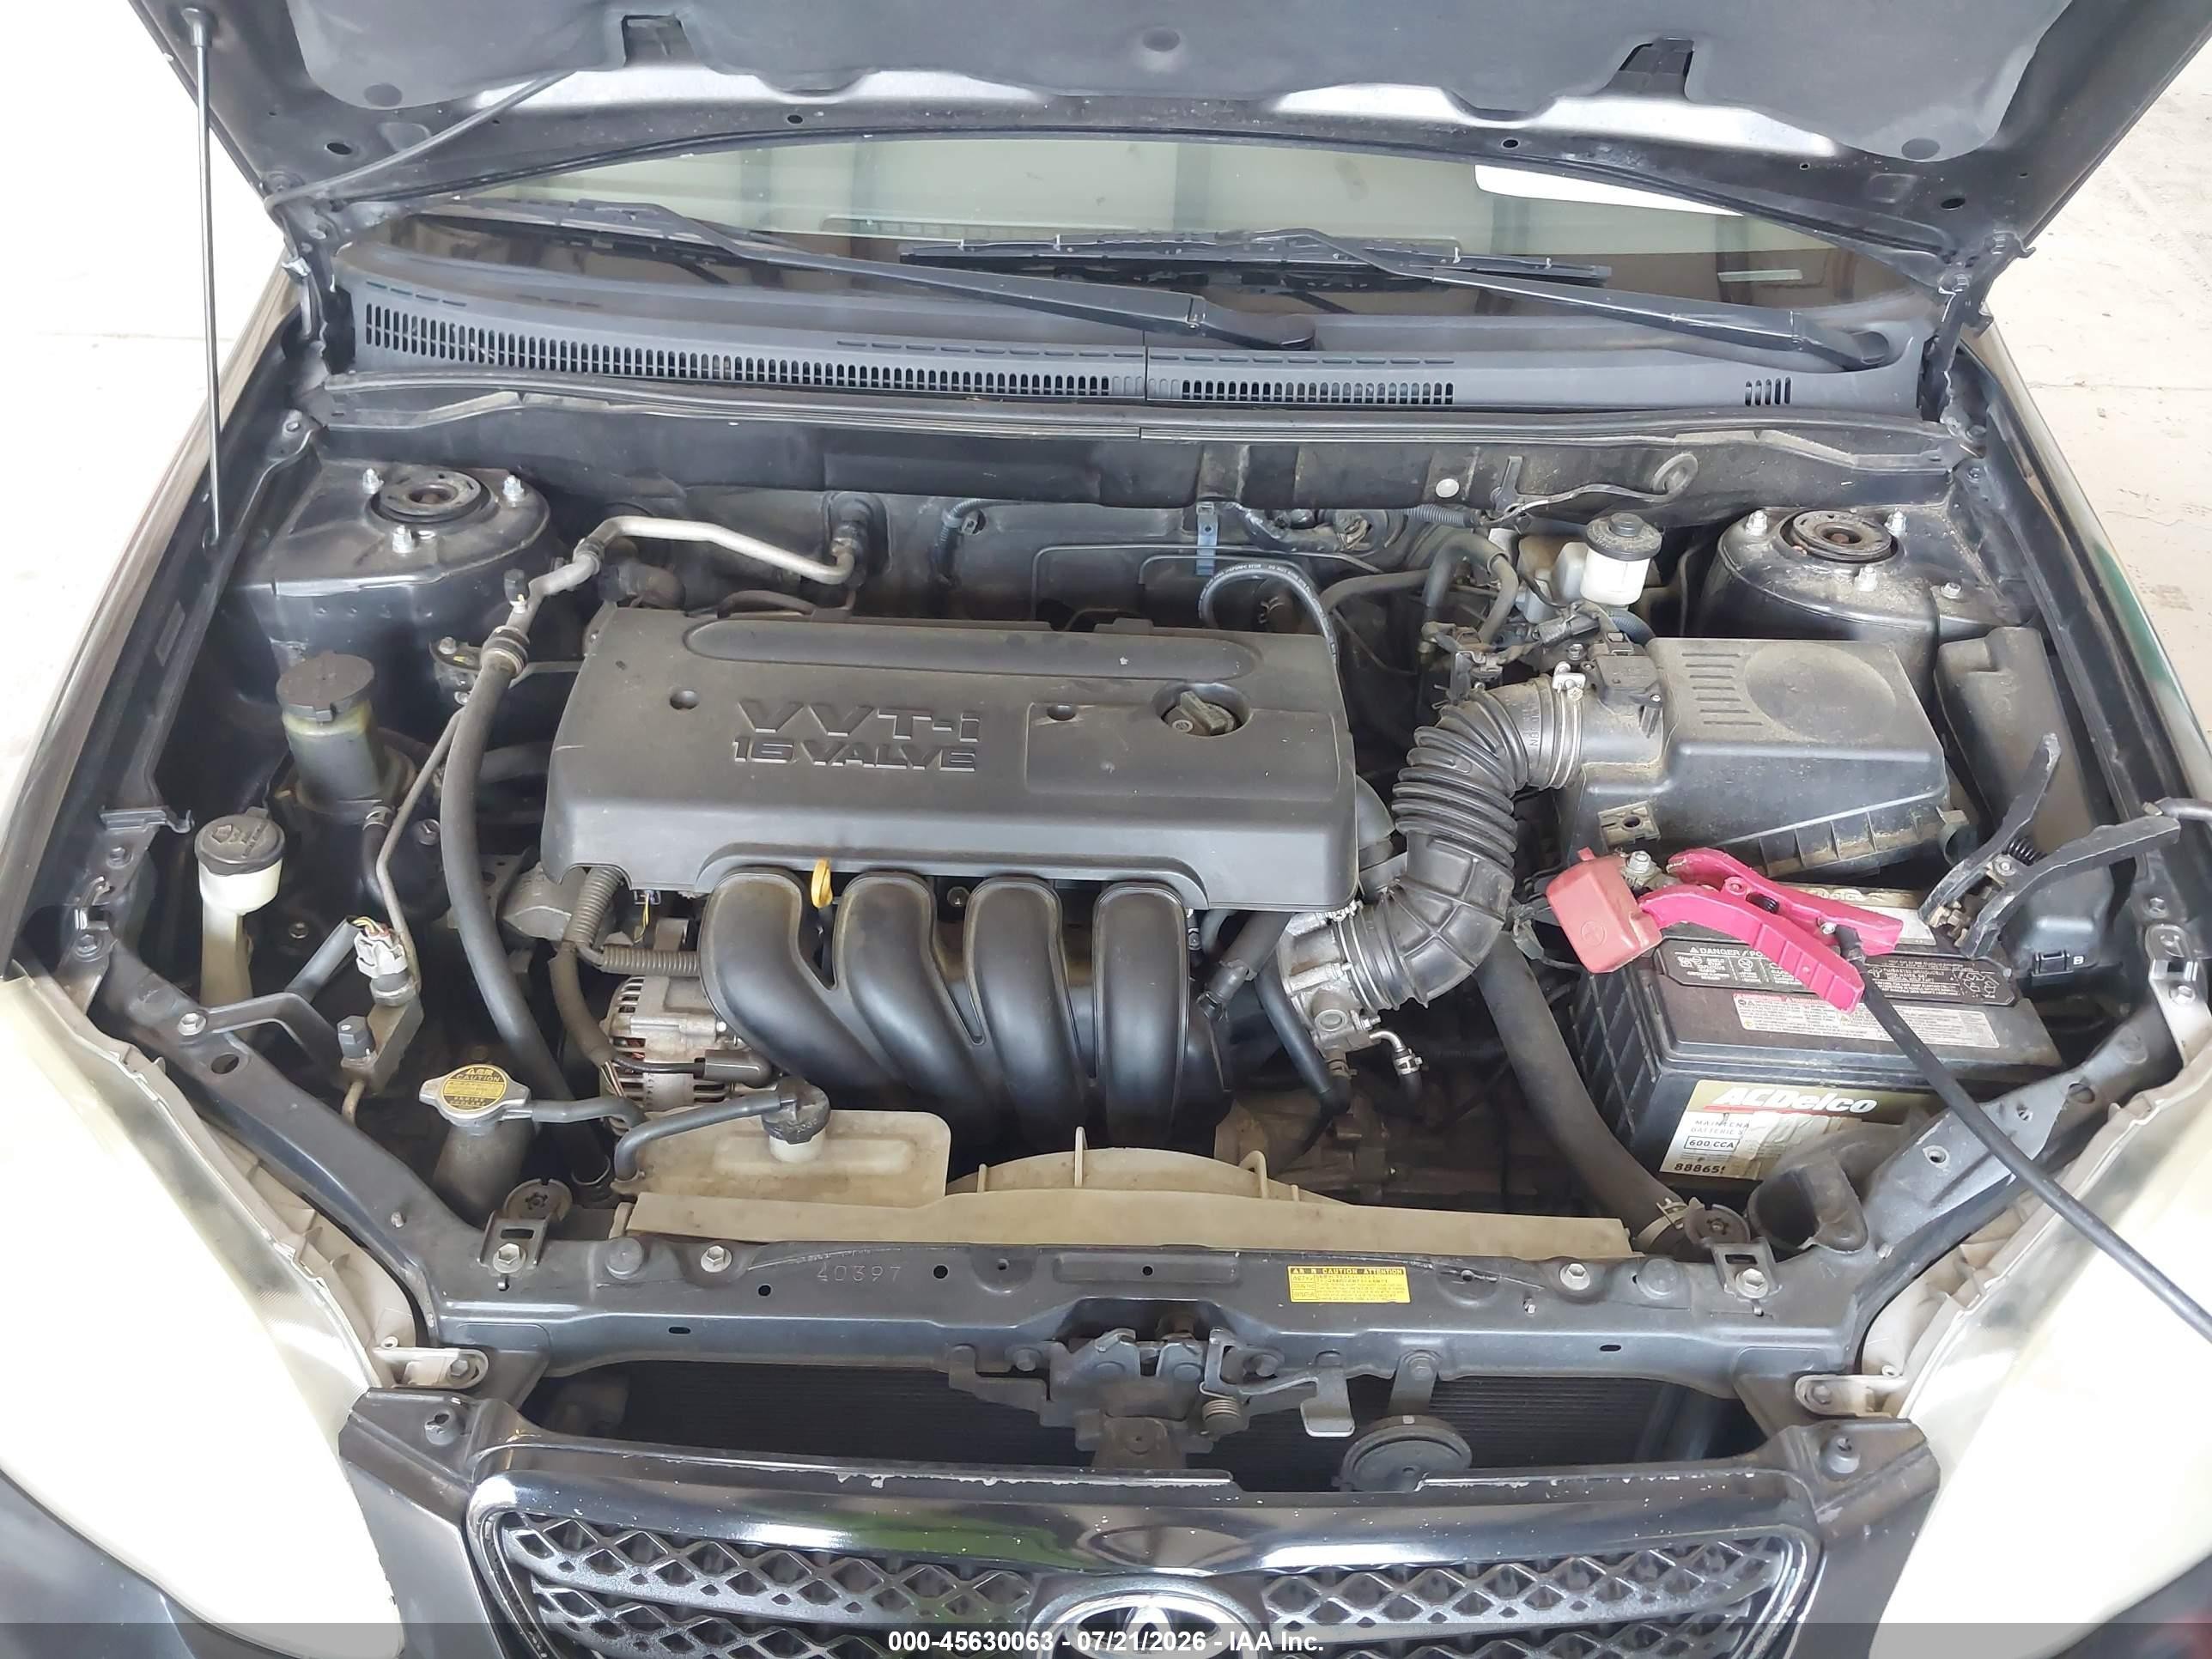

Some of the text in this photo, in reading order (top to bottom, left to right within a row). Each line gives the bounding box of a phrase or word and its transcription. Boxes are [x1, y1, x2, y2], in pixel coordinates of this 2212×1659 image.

[738, 700, 980, 742] VVT-i
[732, 737, 976, 772] 16 VALVE
[456, 1073, 501, 1082] CAUTION
[1712, 1087, 1879, 1113] ACDelco
